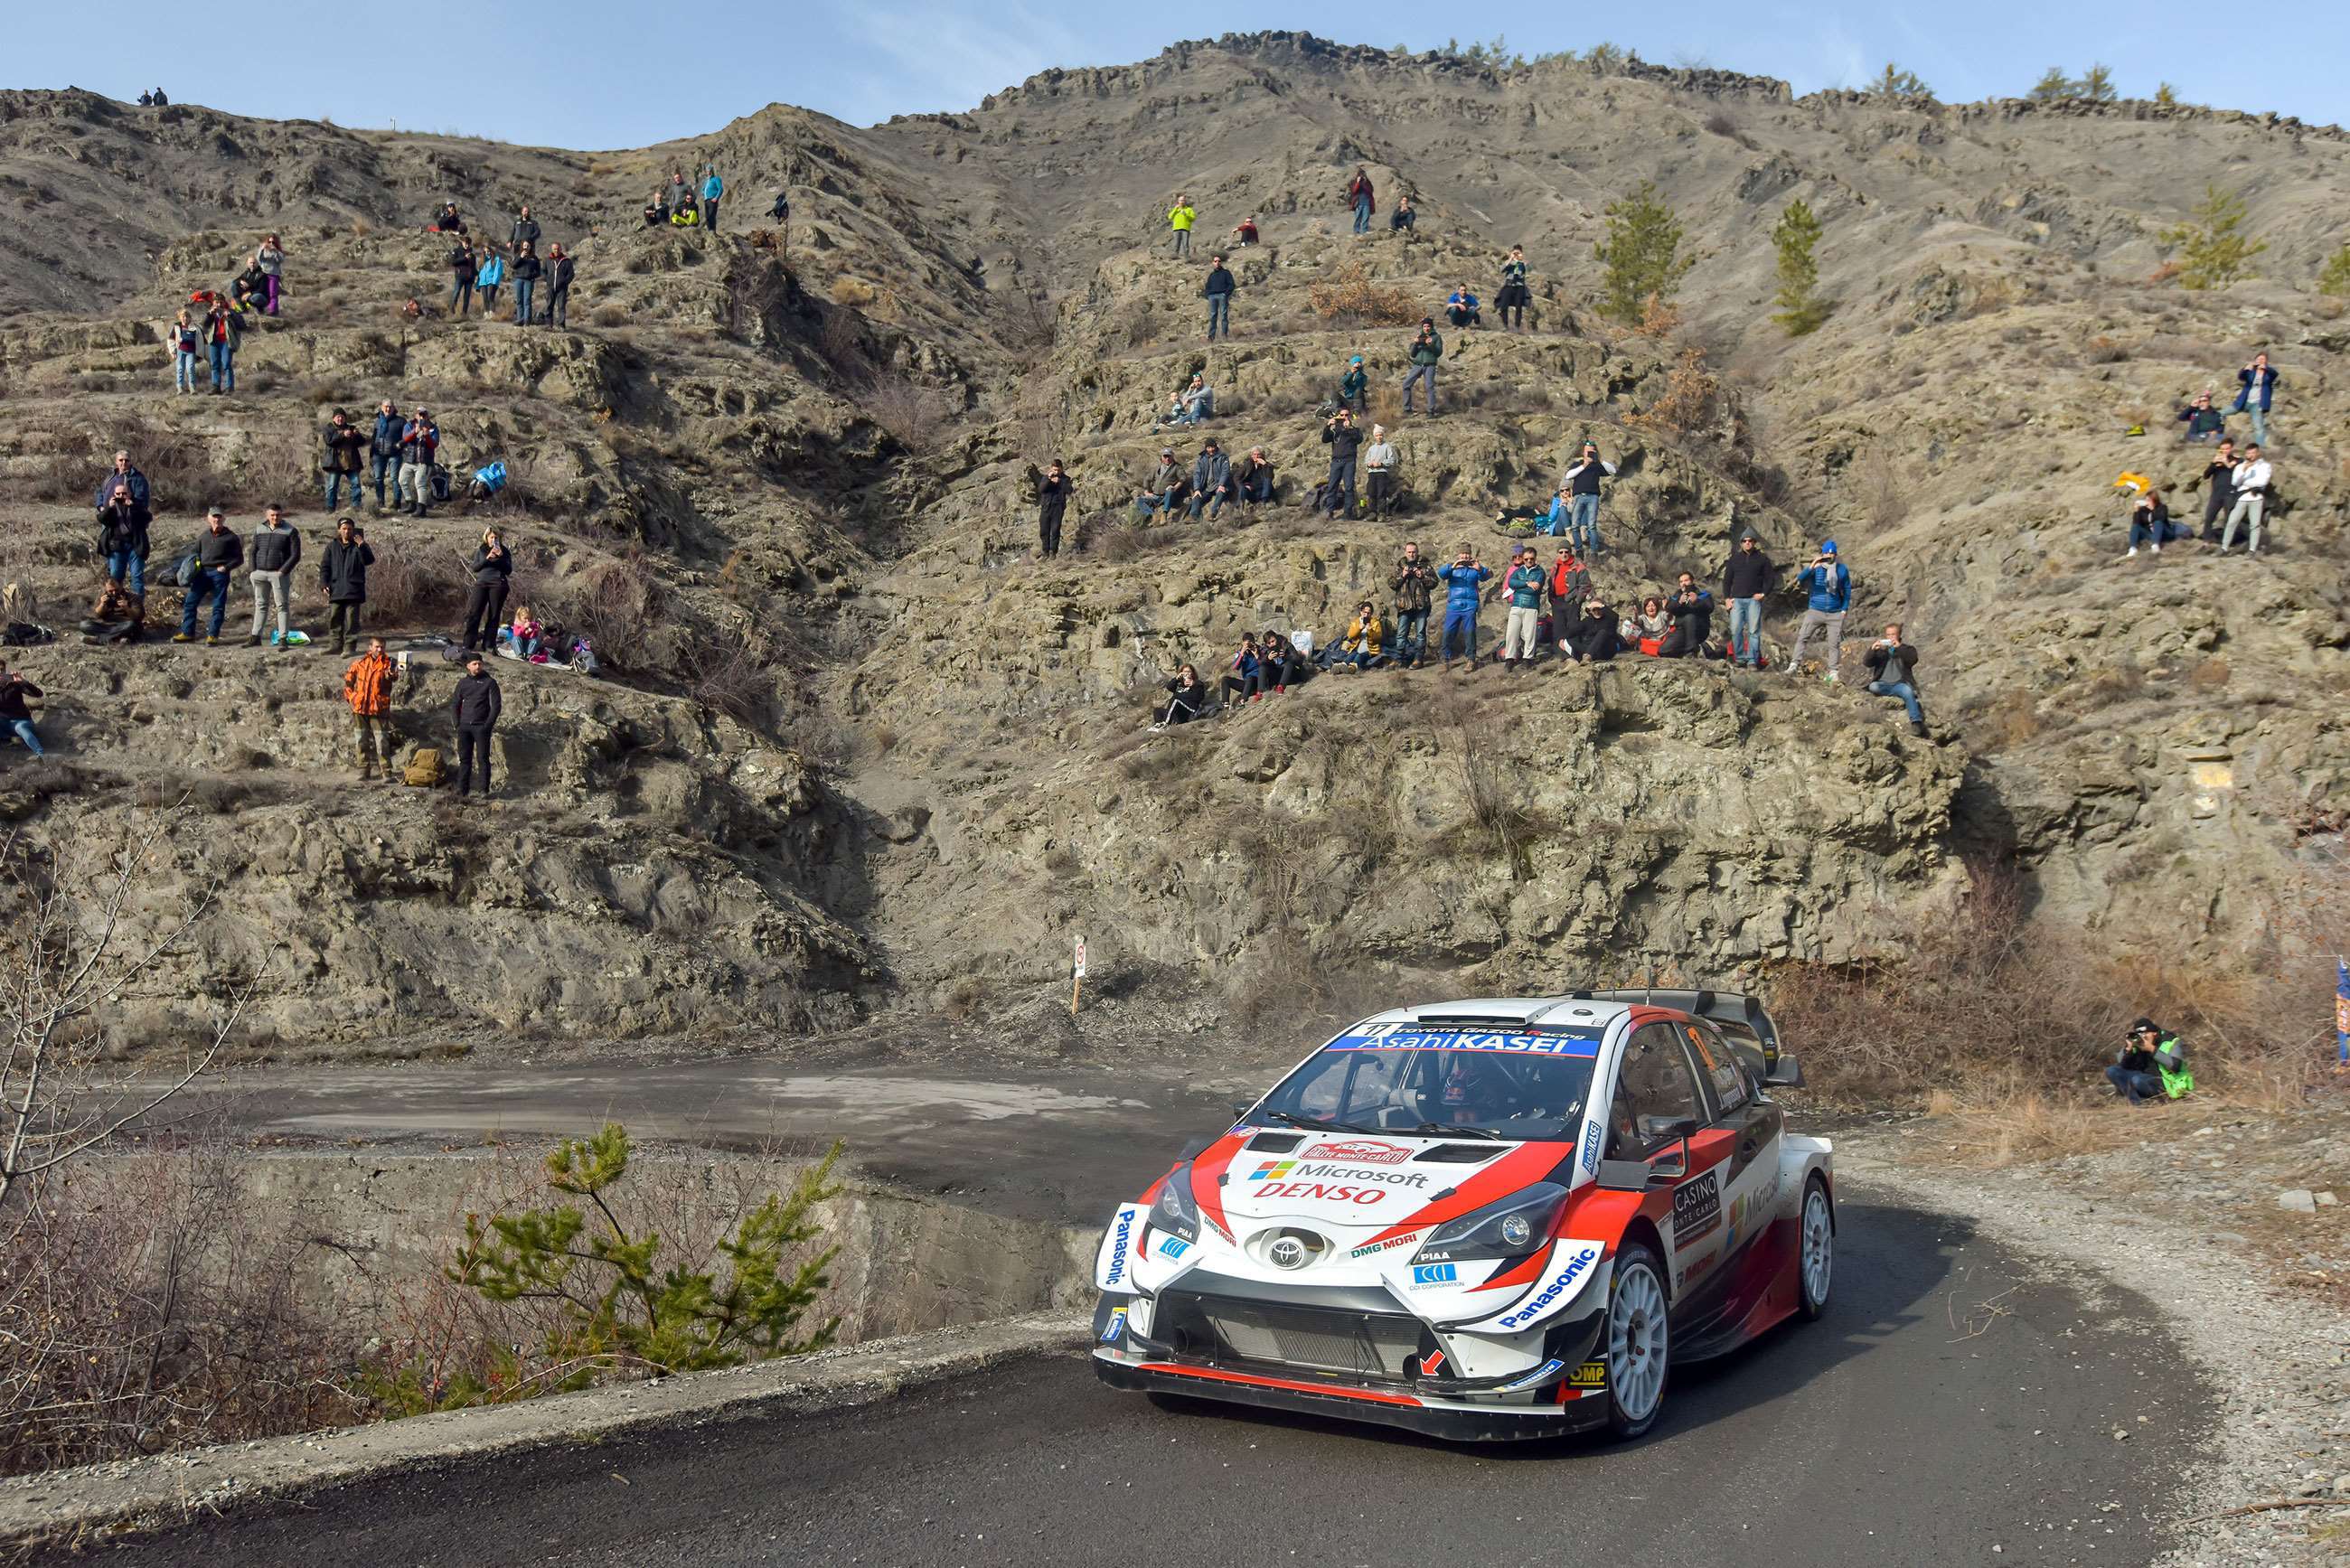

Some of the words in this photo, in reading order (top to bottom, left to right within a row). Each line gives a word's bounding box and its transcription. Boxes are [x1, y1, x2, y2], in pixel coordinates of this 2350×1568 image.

[1366, 1025, 1388, 1037] 17
[1525, 1029, 1586, 1039] Racing
[1358, 1034, 1568, 1053] AsahiKASEI
[1584, 1121, 1601, 1171] AsahiKASEI
[1296, 1164, 1429, 1188] Microsoft
[1254, 1183, 1386, 1204] DENSO
[1675, 1176, 1716, 1211] CASINO
[1177, 1226, 1193, 1239] PIAA
[1205, 1216, 1218, 1234] DMG
[1218, 1228, 1236, 1248] MORI
[1105, 1209, 1135, 1285] Panasonic
[1350, 1244, 1382, 1259] DMG
[1383, 1234, 1417, 1250] MORI
[1420, 1251, 1451, 1262] PIAA
[1422, 1281, 1465, 1290] CORPORATION
[1498, 1248, 1595, 1329] Panasonic
[1569, 1366, 1605, 1381] OMP
